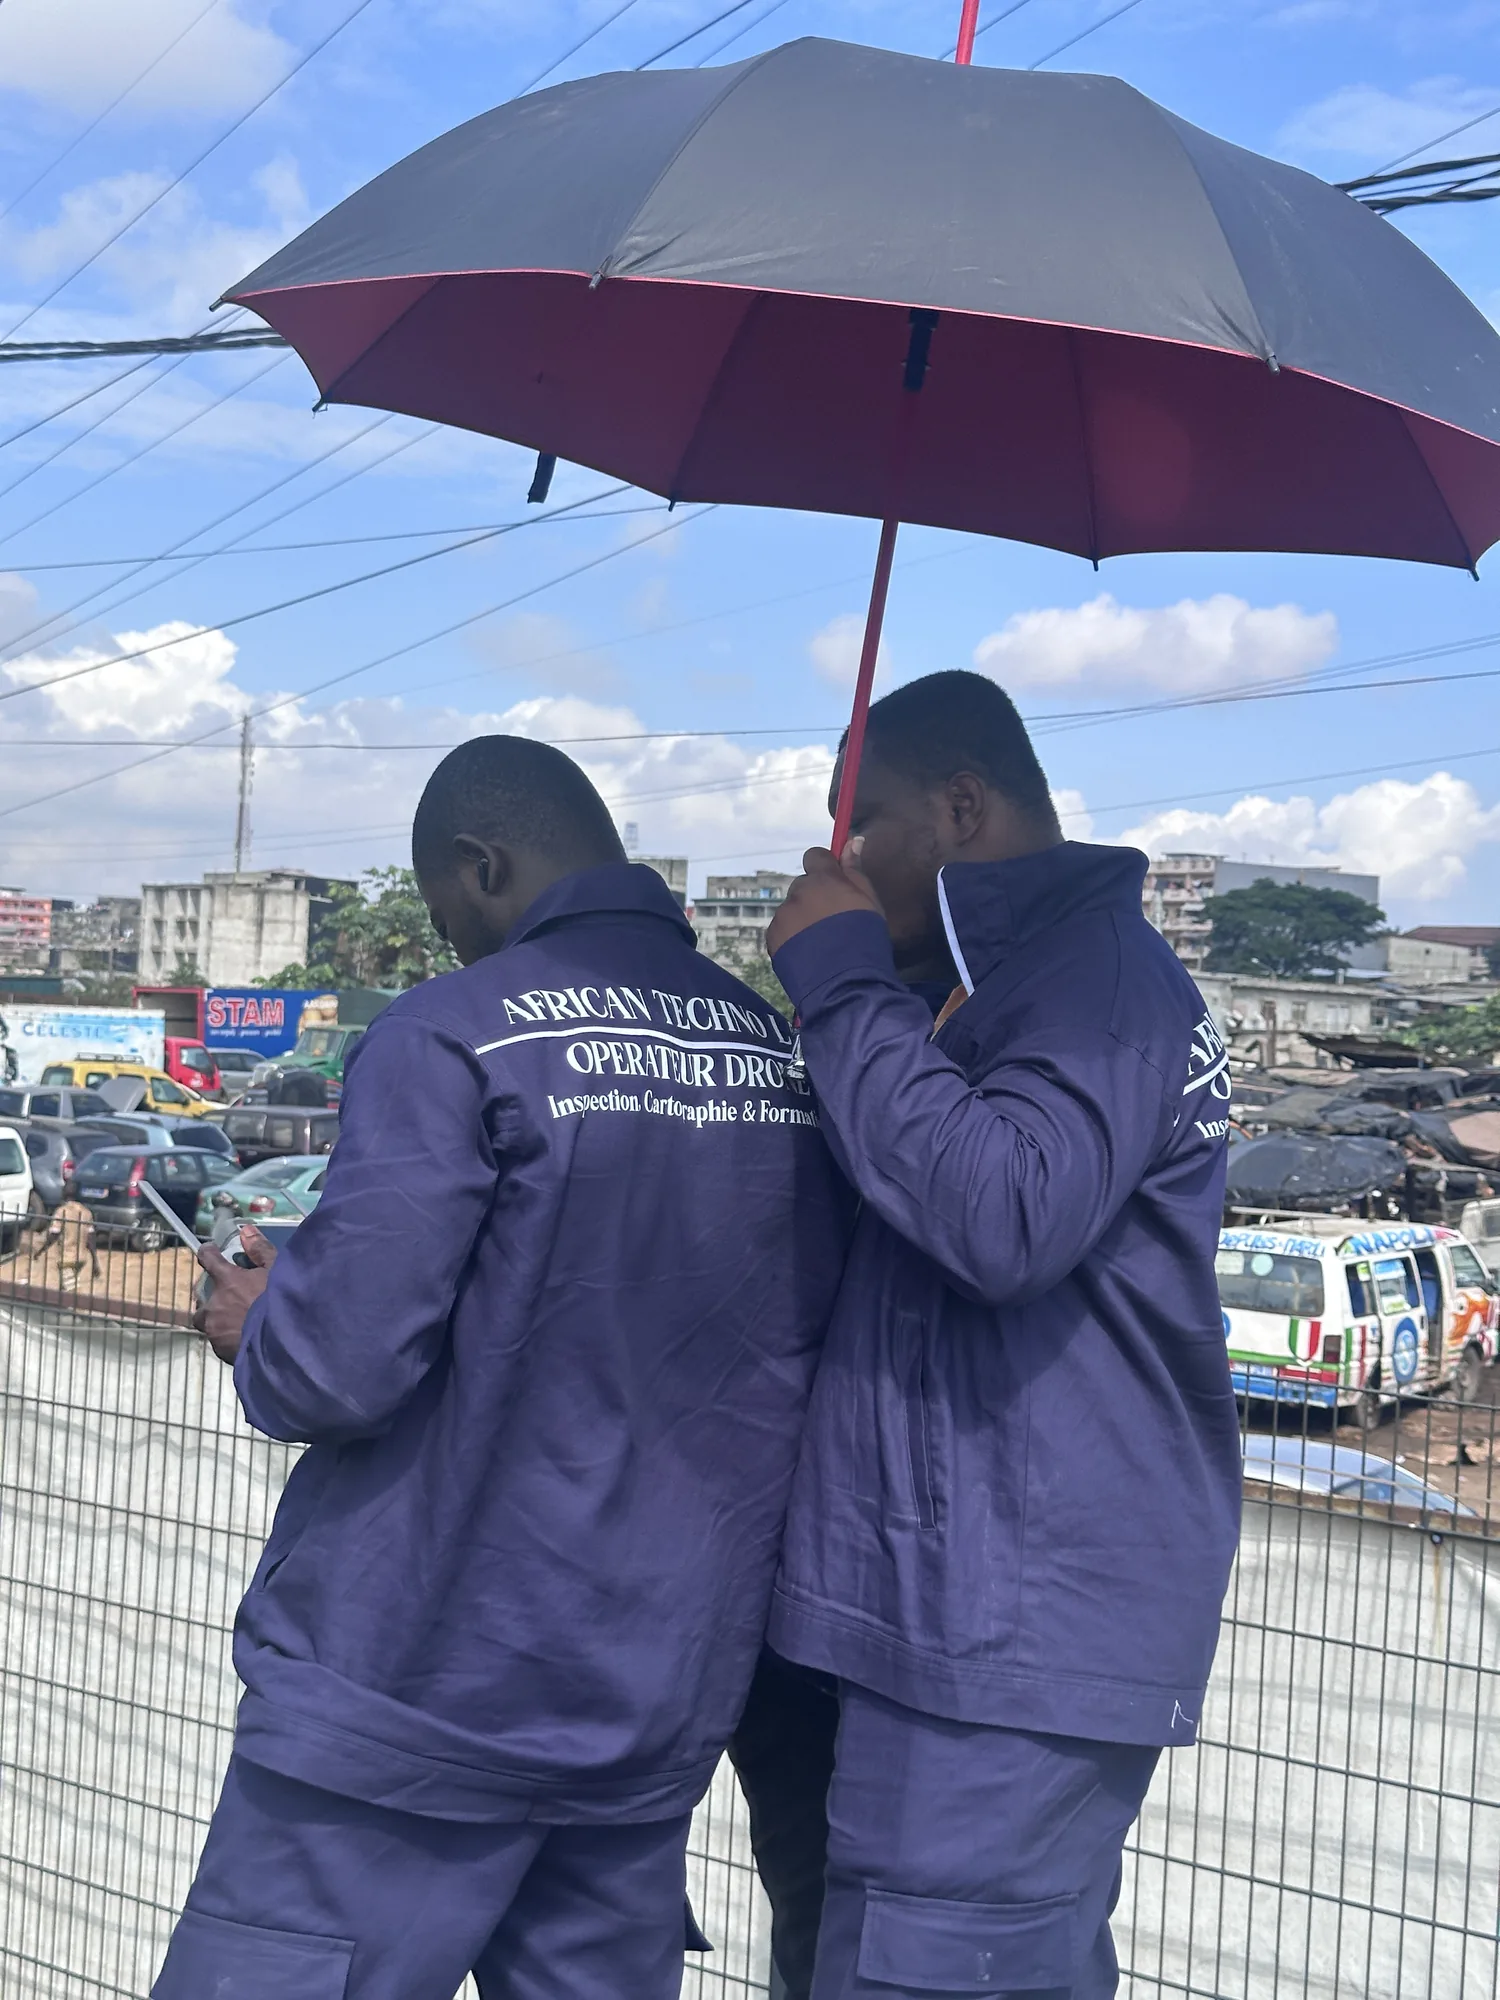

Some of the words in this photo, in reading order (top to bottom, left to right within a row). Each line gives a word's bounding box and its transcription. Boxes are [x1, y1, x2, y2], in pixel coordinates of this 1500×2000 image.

[207, 996, 285, 1028] STAM
[502, 986, 652, 1025] AFRICAN
[651, 989, 768, 1039] TECHNO
[566, 1040, 717, 1087] OPERATEUR
[742, 1100, 756, 1122] &
[1350, 1226, 1434, 1256] NAPOLI
